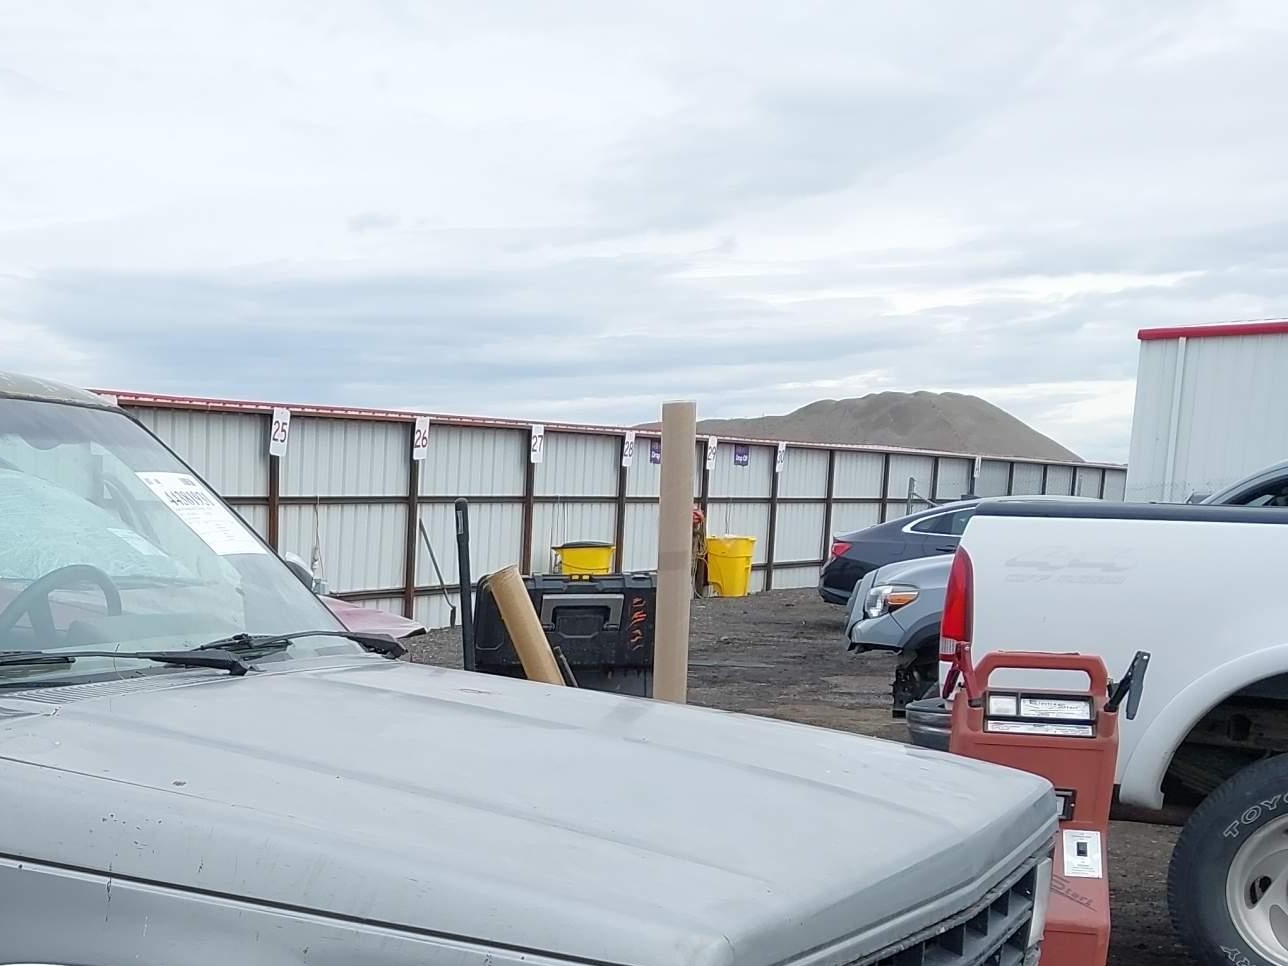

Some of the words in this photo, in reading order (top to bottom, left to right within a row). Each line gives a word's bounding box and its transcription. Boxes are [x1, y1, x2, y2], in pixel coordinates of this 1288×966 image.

[272, 420, 288, 443] 25
[414, 429, 428, 448] 26
[532, 435, 543, 453] 27
[623, 441, 634, 457] 28
[707, 446, 716, 461] 29
[1223, 793, 1288, 838] TOY
